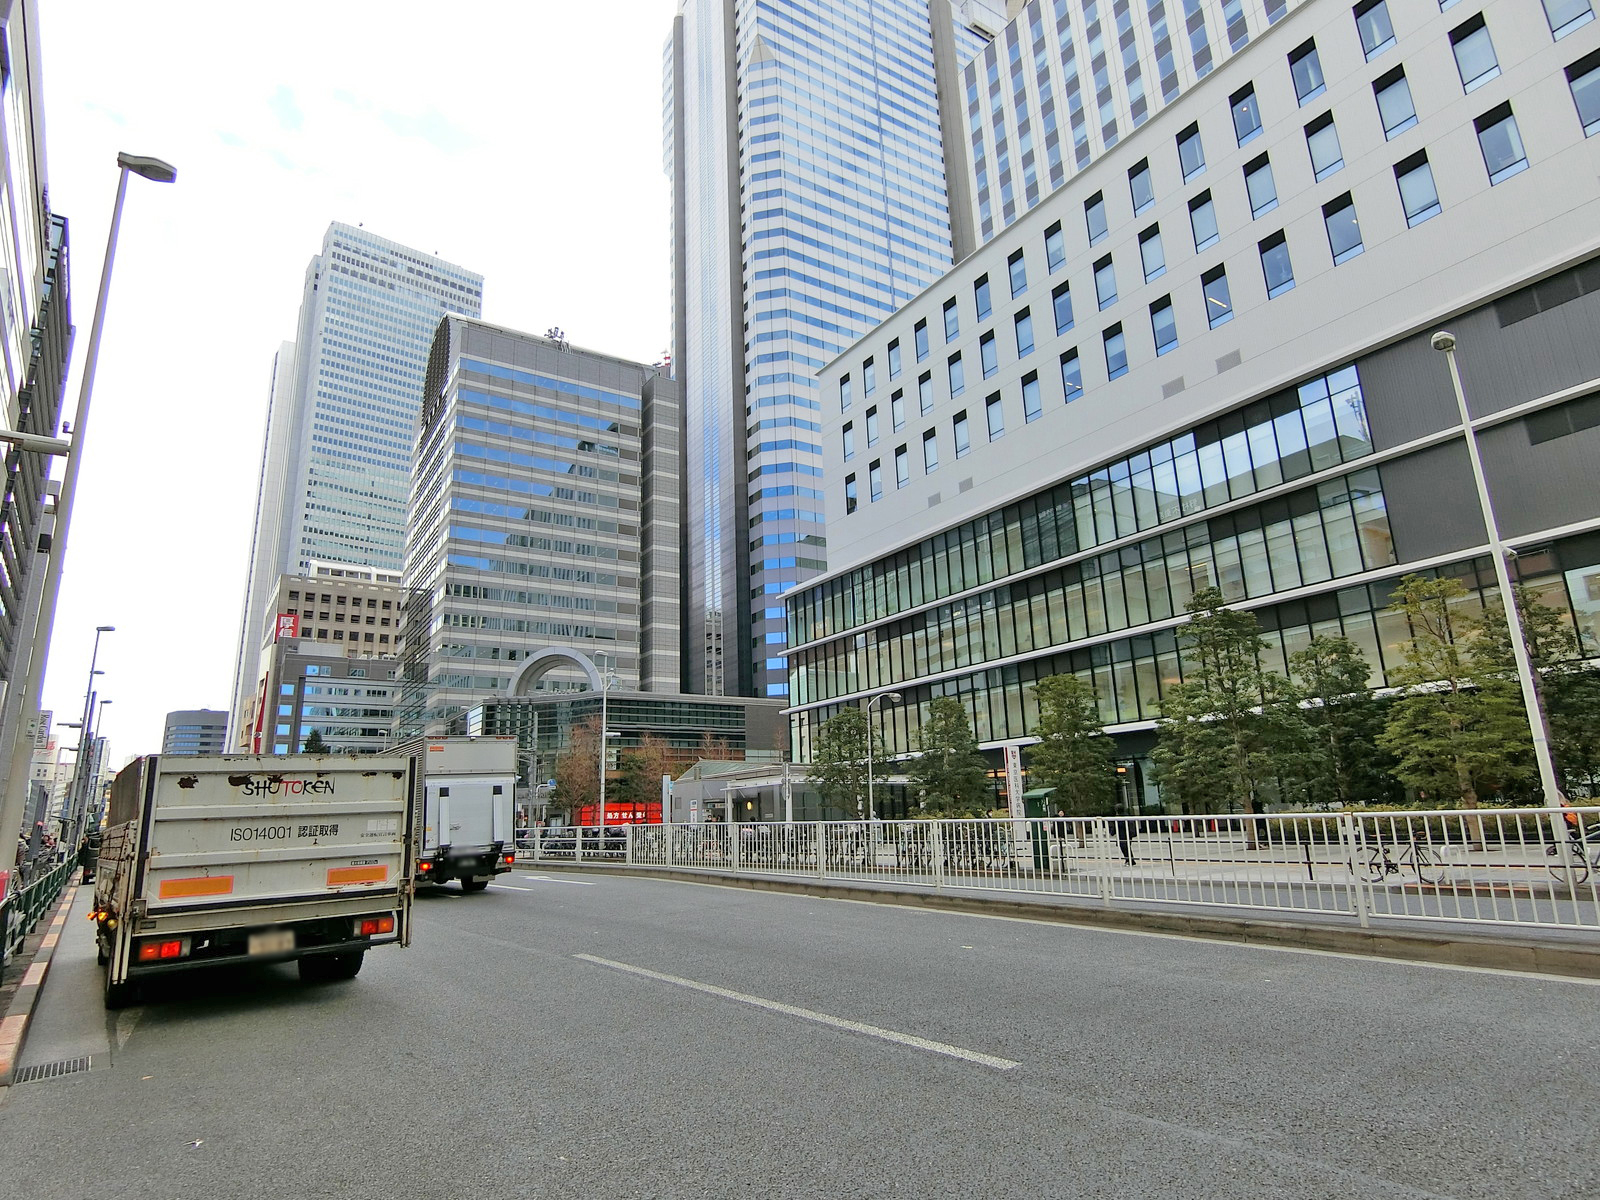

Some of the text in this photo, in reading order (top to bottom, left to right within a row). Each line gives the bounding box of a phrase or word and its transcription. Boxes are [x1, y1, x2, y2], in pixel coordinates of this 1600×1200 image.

[242, 777, 335, 798] SHUTOKEN
[230, 824, 339, 841] ISO14001 認証取得
